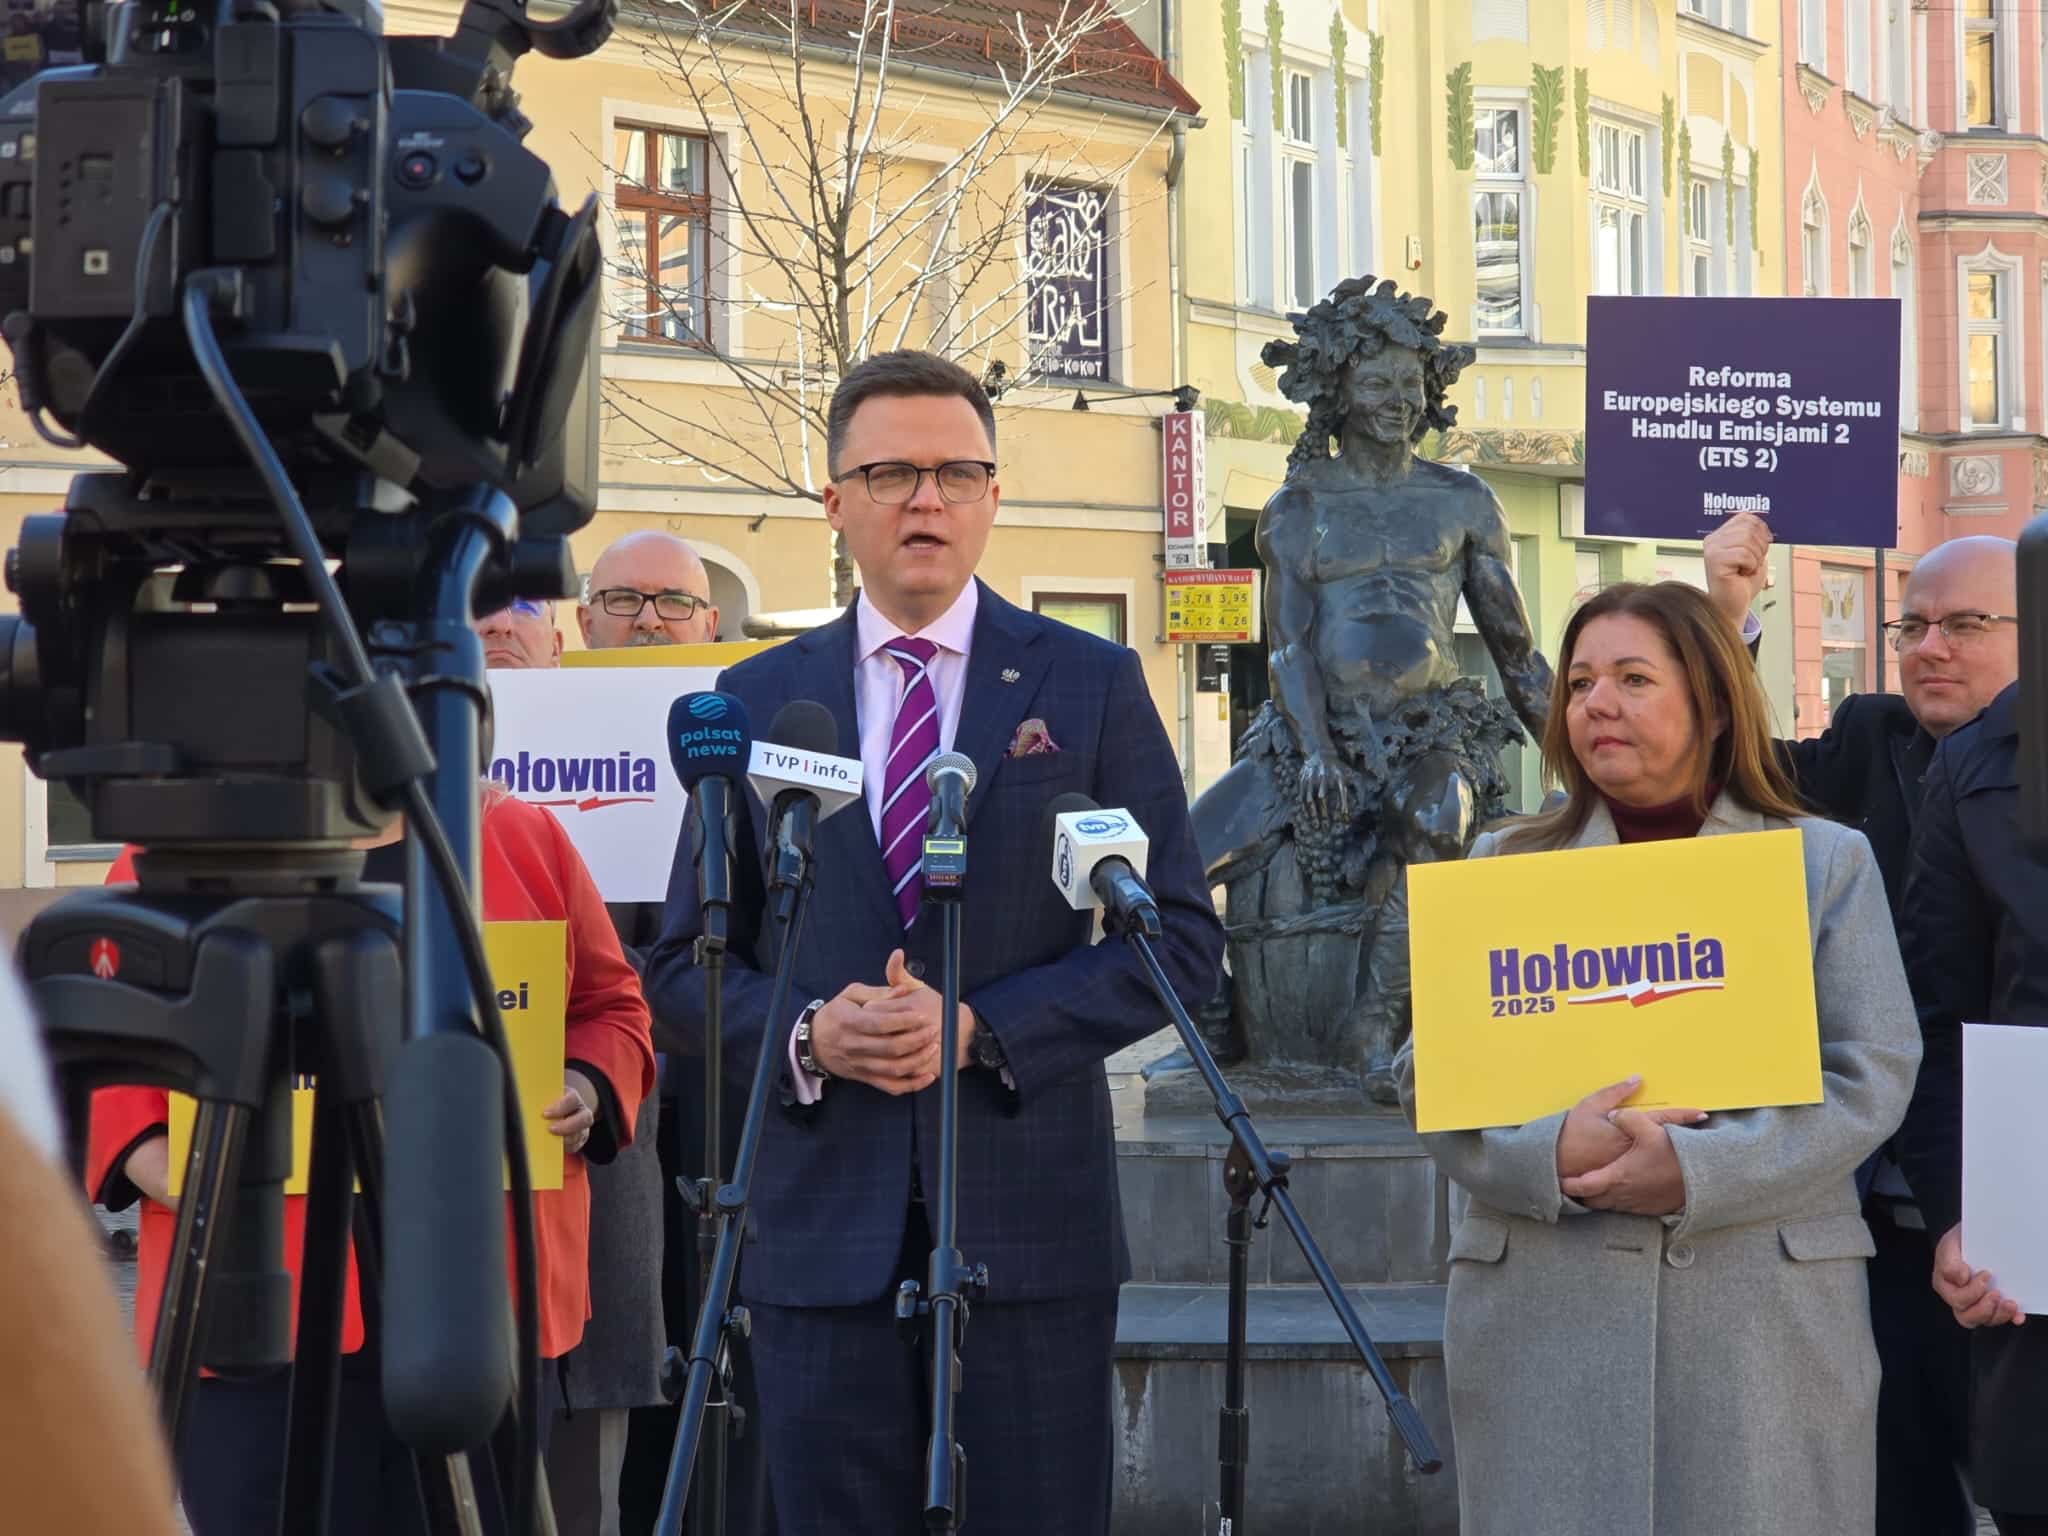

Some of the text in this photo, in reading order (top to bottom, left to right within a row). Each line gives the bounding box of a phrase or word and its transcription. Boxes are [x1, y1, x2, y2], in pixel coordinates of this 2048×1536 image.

[1688, 366, 1792, 389] Reforma
[1603, 391, 1881, 419] Europejskiego Systemu
[1631, 418, 1850, 446] Handlu Emisjami 2
[1171, 419, 1189, 527] KANTOR
[1699, 446, 1778, 473] (ETS 2)
[680, 725, 743, 748] polsat
[687, 743, 738, 760] news
[762, 751, 801, 772] TVP
[484, 751, 656, 793] ołownia
[1488, 932, 1725, 998] Hołownia
[1491, 995, 1555, 1018] 2025
